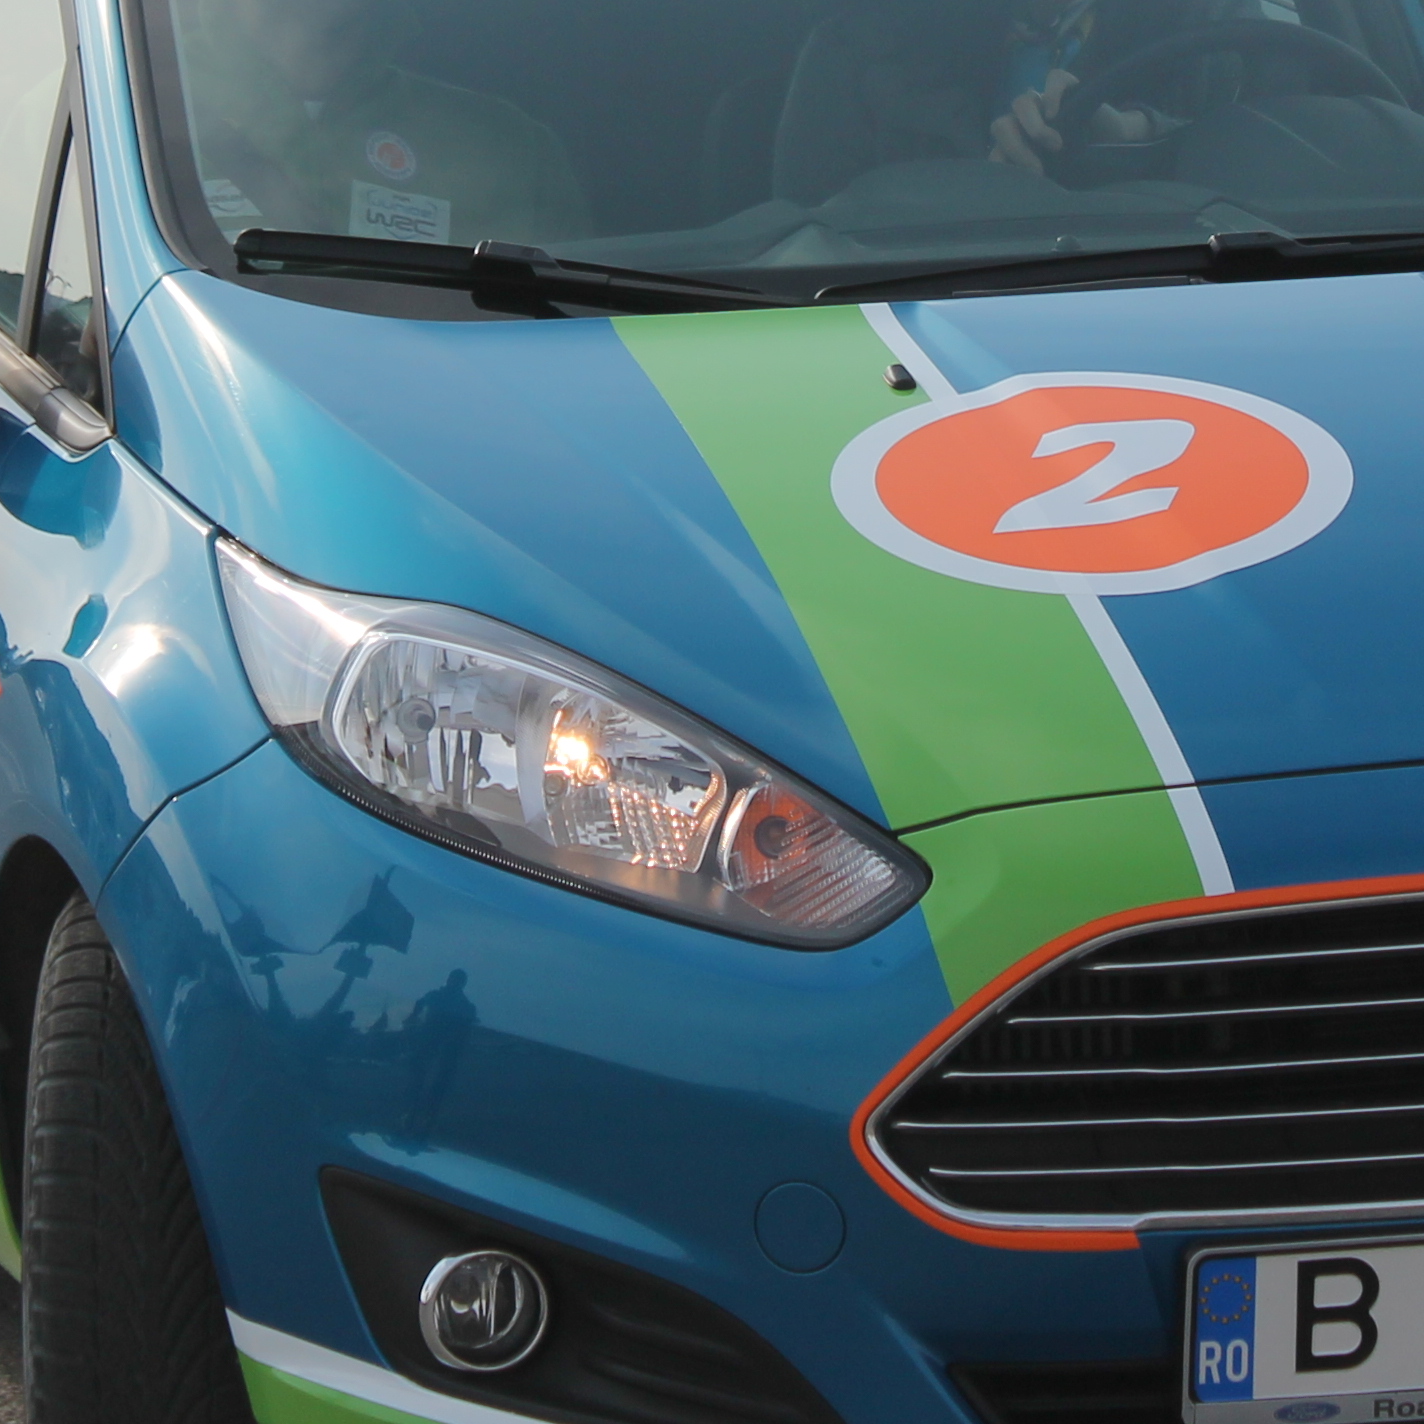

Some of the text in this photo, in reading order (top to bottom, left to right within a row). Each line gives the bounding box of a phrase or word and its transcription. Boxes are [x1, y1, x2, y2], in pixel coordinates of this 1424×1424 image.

[991, 417, 1196, 534] 2
[1198, 1339, 1250, 1385] RO
[1294, 1256, 1380, 1373] B
